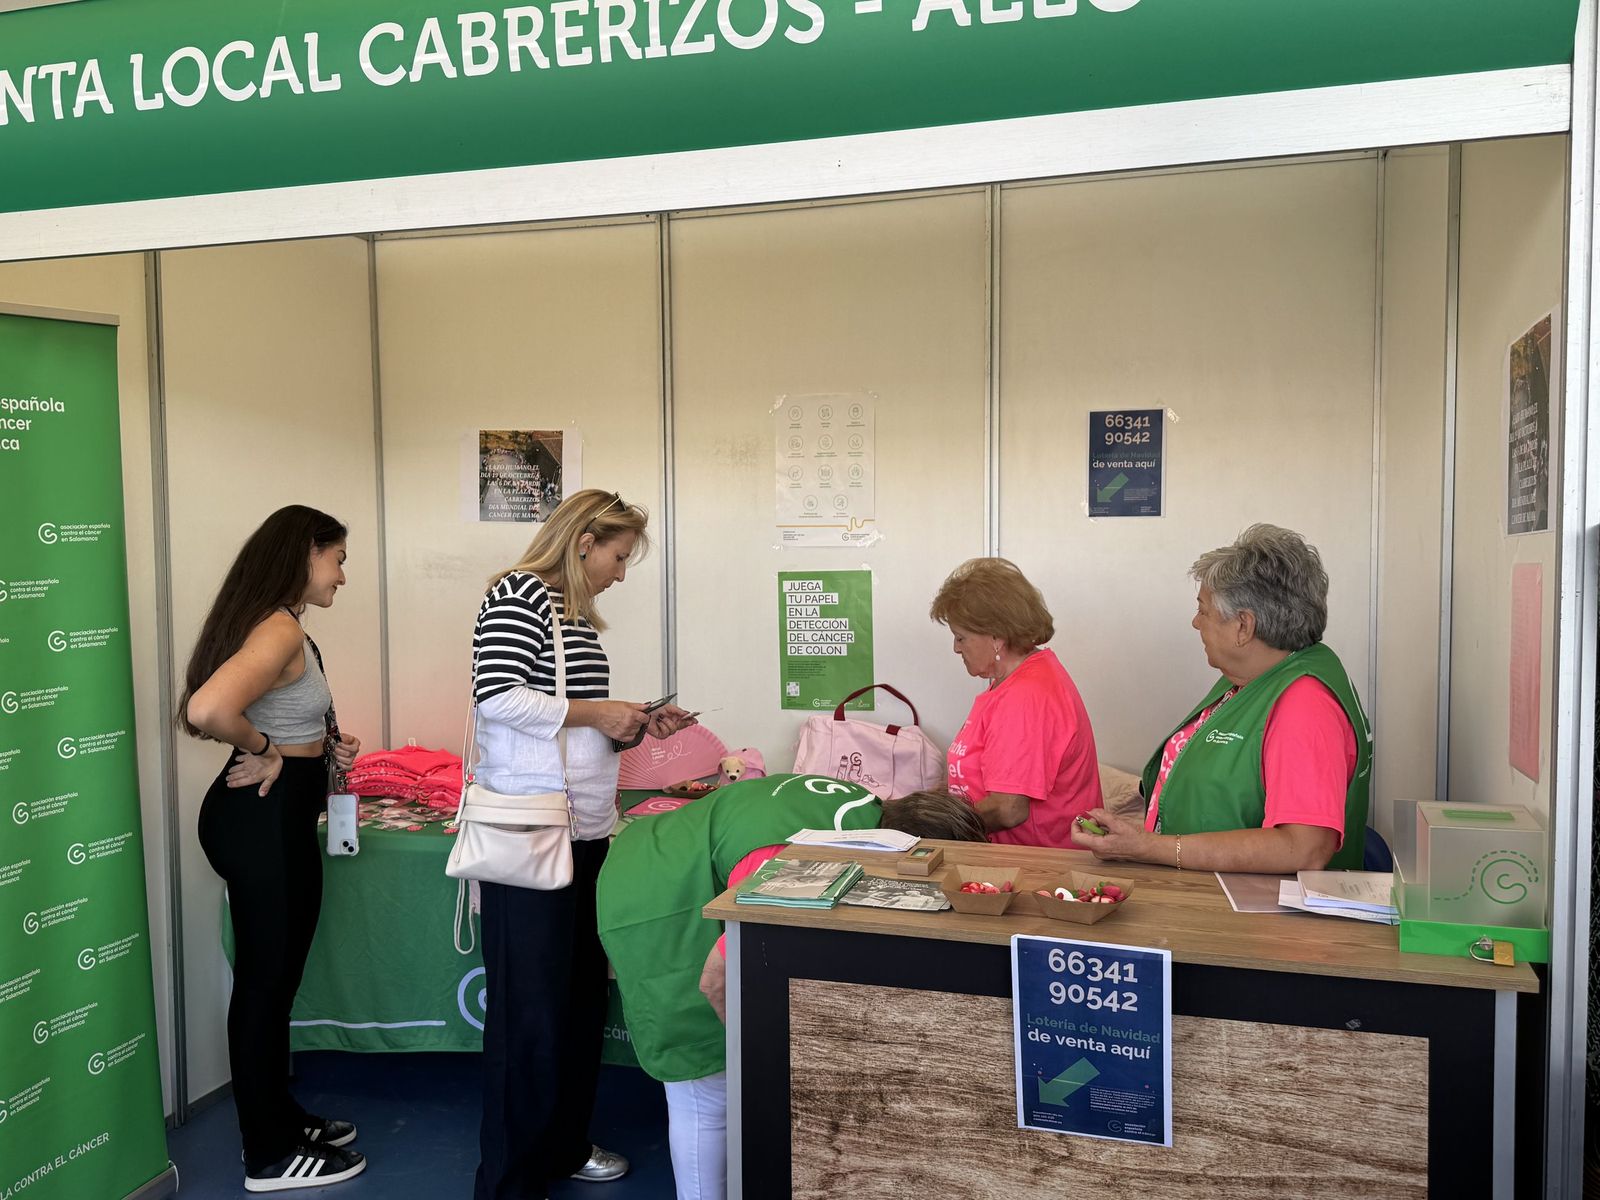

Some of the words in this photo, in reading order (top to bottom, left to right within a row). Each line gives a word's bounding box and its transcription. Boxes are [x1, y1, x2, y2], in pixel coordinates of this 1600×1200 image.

[130, 32, 341, 111] LOCAL
[359, 0, 825, 86] CABRERIZOS
[0, 396, 65, 414] spañola
[1104, 414, 1151, 429] 66341
[0, 438, 20, 450] ca
[1105, 432, 1151, 445] 90542
[1092, 460, 1105, 468] de
[1107, 460, 1133, 468] venta
[788, 582, 821, 591] JUEGA
[789, 594, 802, 603] TU
[805, 594, 837, 603] PAPEL
[789, 607, 802, 616] EN
[805, 607, 818, 616] LA
[789, 633, 809, 642] DEL
[789, 646, 803, 654] DE
[949, 760, 964, 778] el
[89, 845, 104, 853] contra
[41, 913, 55, 922] contra
[1048, 948, 1138, 985] 66341
[1049, 981, 1138, 1013] 90542
[51, 1020, 66, 1030] contra
[1079, 1021, 1097, 1034] de
[1101, 1026, 1161, 1044] Navidad
[1028, 1028, 1051, 1043] de
[1055, 1033, 1106, 1053] venta
[1110, 1045, 1151, 1060] aquí
[14, 1162, 54, 1193] CONTRA
[54, 1155, 68, 1168] EL
[68, 1132, 110, 1160] CÁNCER
